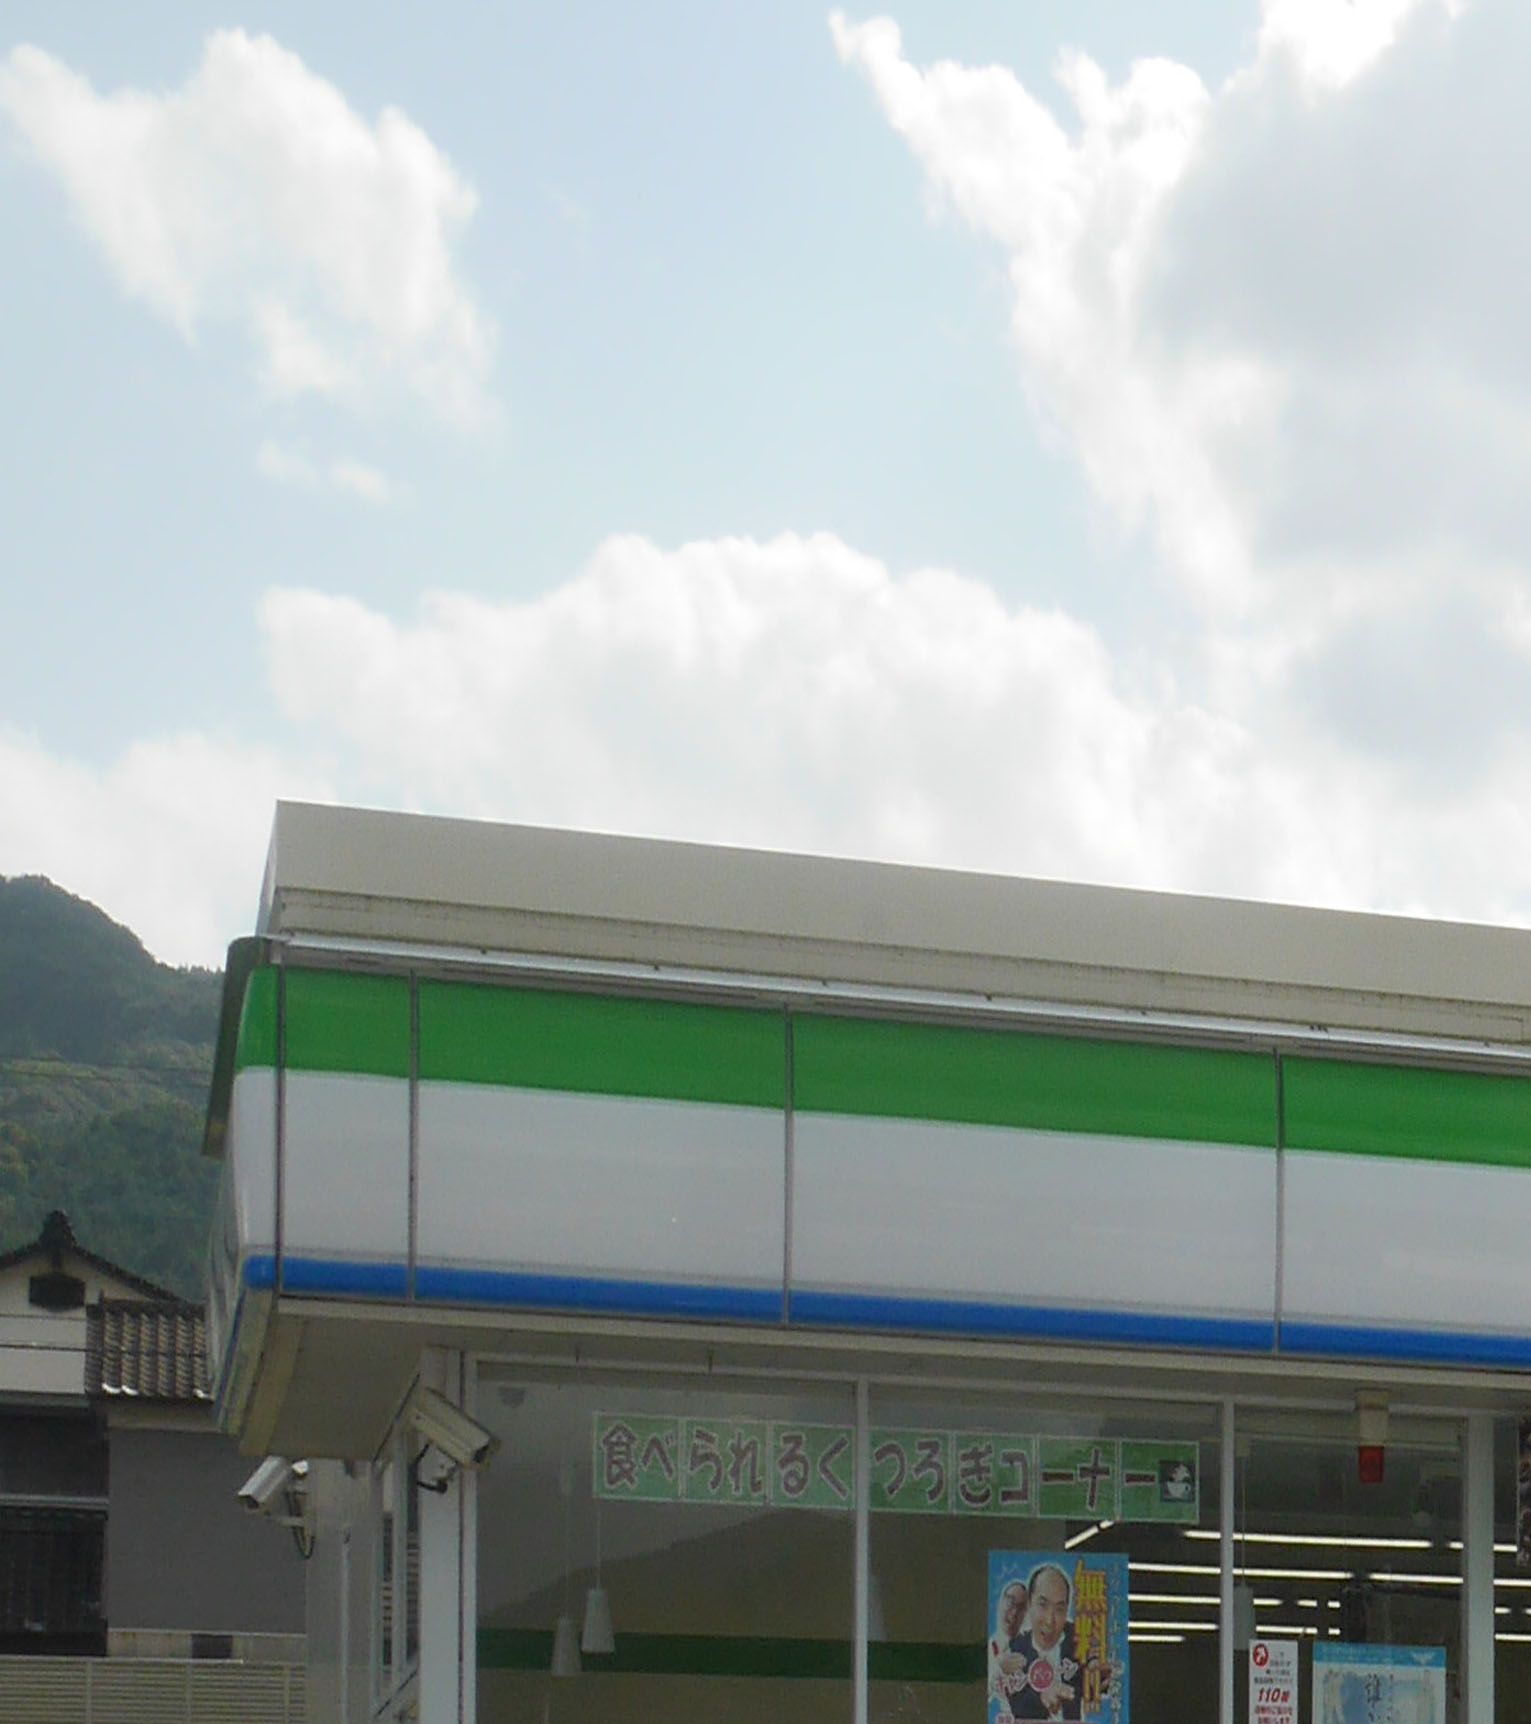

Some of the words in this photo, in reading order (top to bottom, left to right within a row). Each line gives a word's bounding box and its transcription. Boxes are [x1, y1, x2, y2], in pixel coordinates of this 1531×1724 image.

[600, 1421, 1158, 1511] 食べられるくつろぎコーナー
